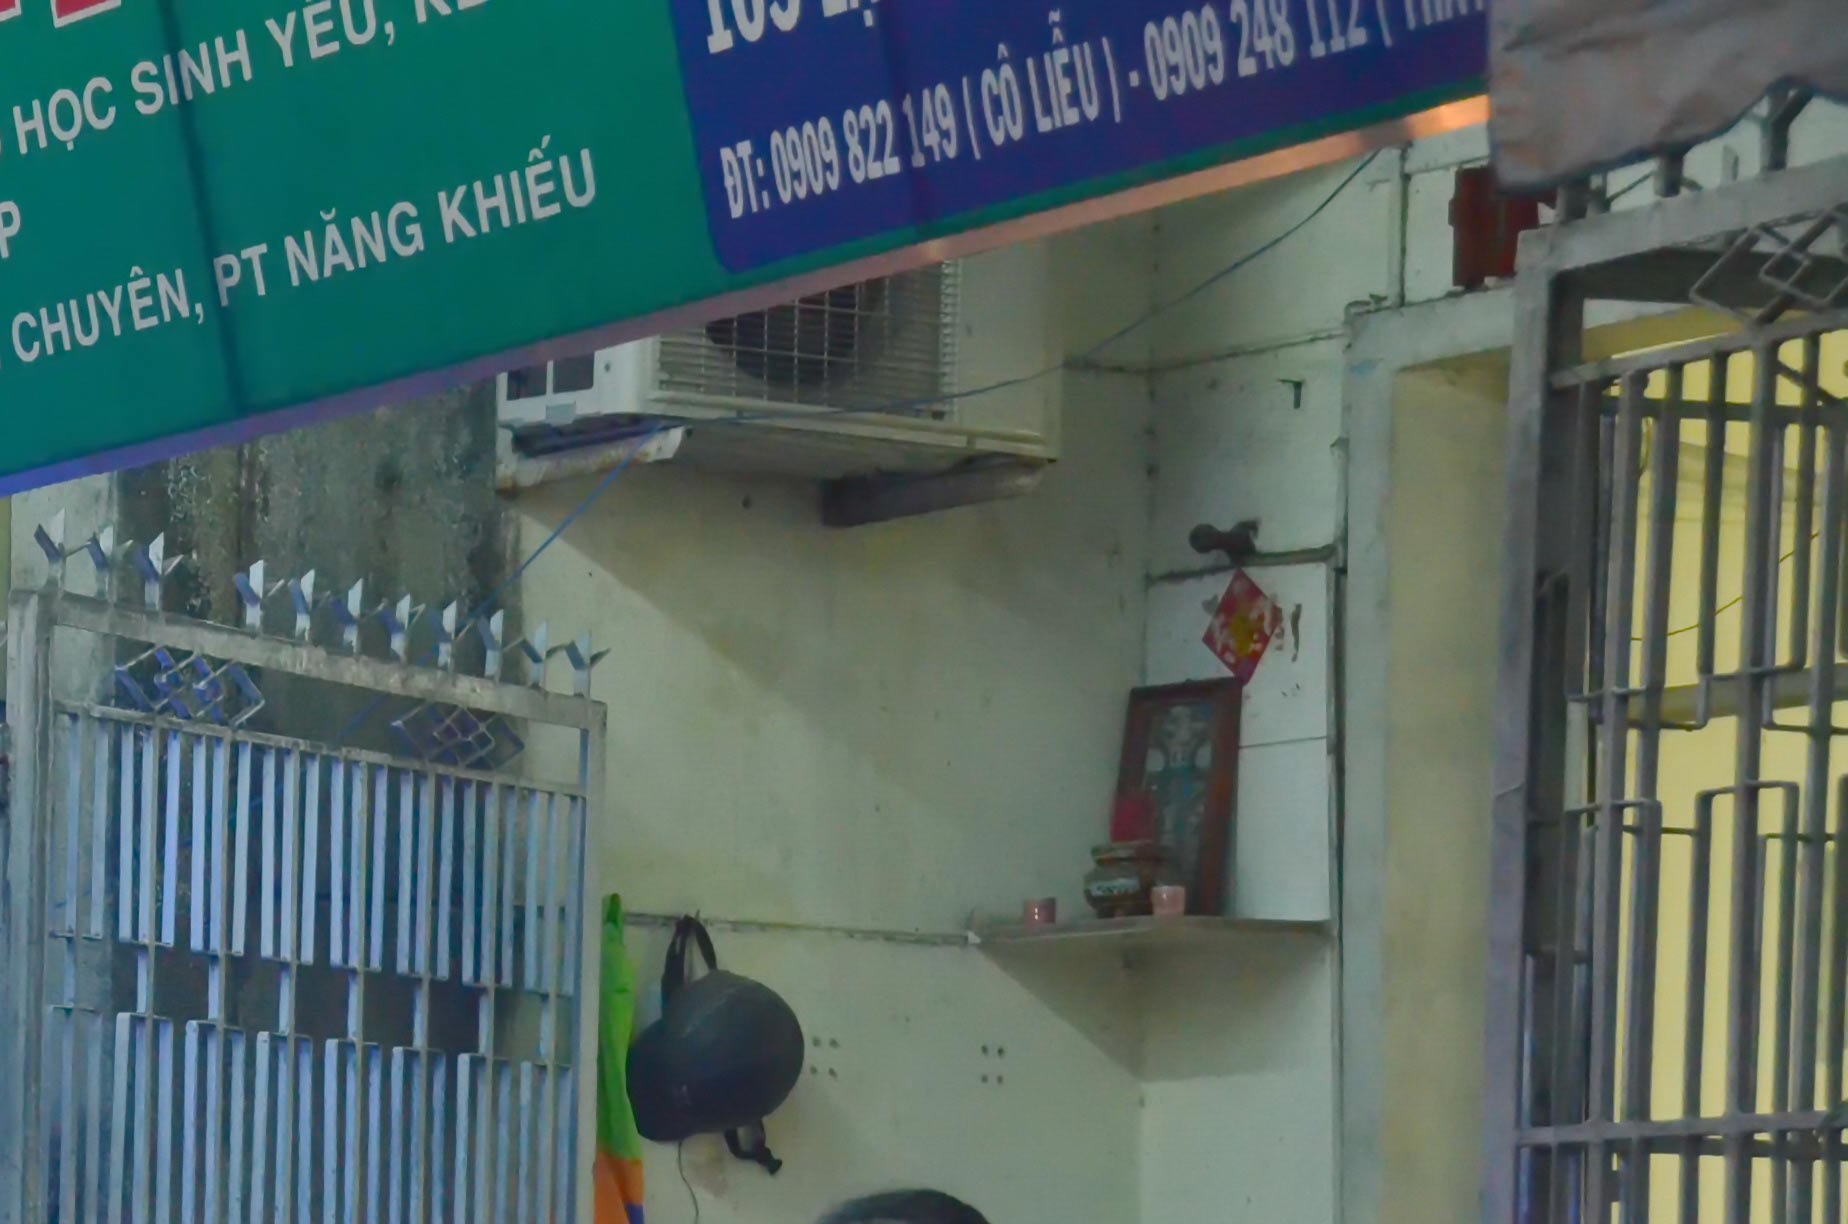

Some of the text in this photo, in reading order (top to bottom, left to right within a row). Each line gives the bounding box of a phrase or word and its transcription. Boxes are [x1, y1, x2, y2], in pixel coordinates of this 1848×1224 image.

[13, 76, 116, 151] HỌC
[131, 28, 253, 115] SINH
[720, 140, 771, 219] ĐT:
[770, 116, 840, 204] 0909
[843, 99, 901, 184] 822
[902, 83, 958, 168] 149
[1144, 4, 1225, 101] 0909
[1231, 0, 1294, 77] 248
[12, 266, 205, 362] CHUYÊN,
[214, 242, 269, 307] PT
[285, 201, 425, 288] NĂNG
[437, 135, 597, 244] KHIẾU
